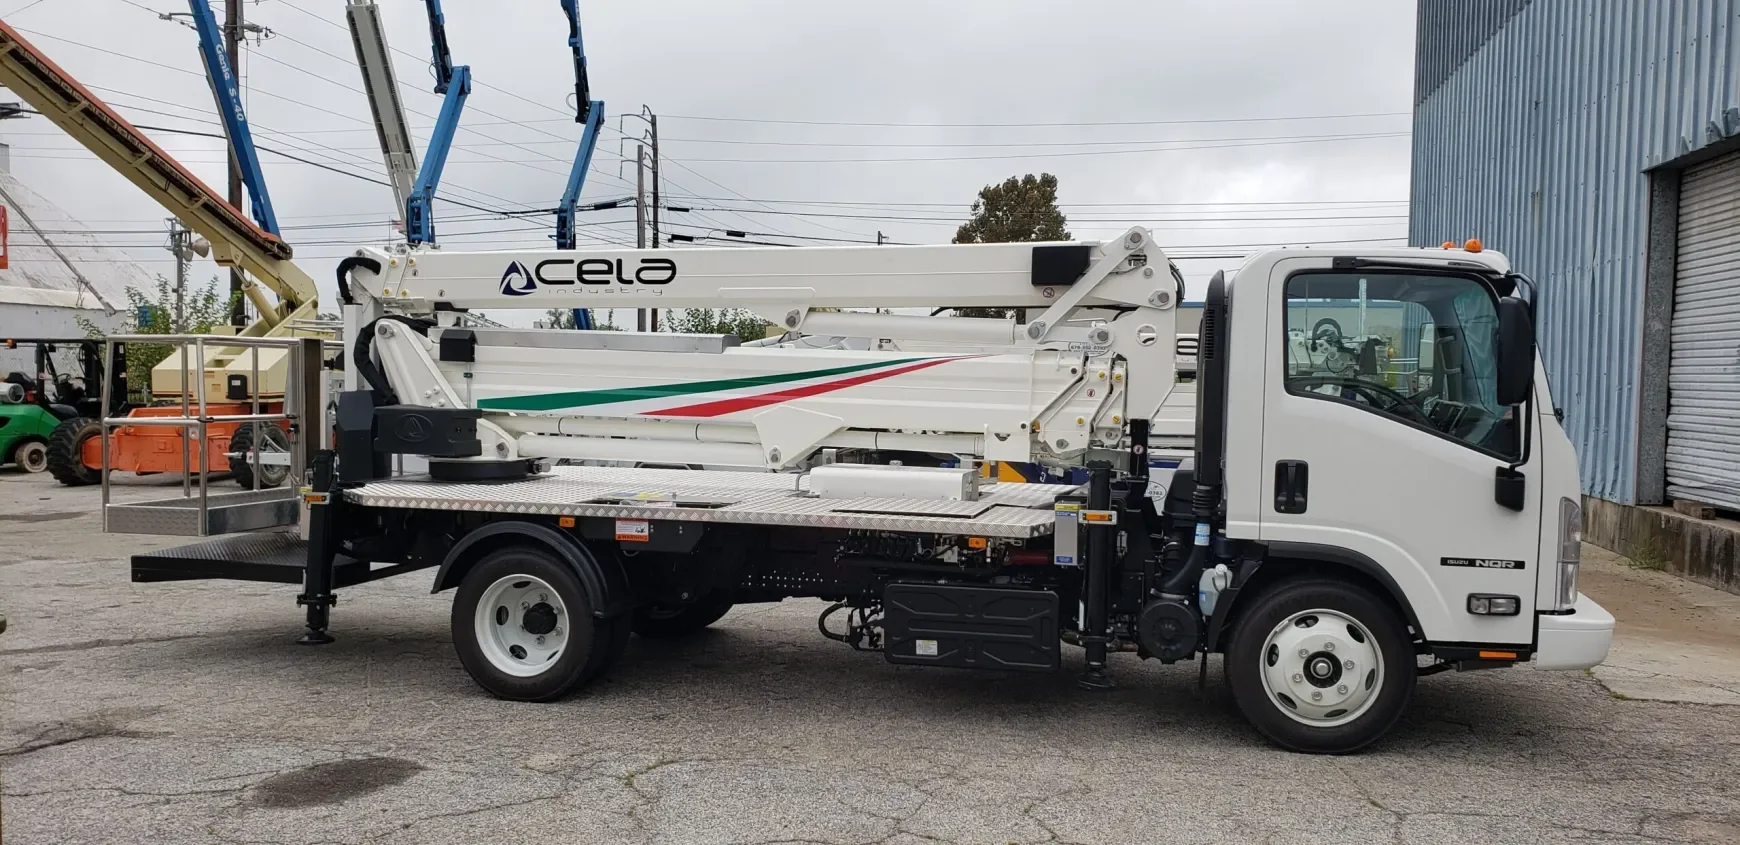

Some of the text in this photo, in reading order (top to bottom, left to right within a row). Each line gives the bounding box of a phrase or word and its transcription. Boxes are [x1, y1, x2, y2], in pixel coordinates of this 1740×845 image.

[216, 44, 244, 121] Genie S-40
[548, 287, 663, 296] industry
[1475, 559, 1515, 569] NQR
